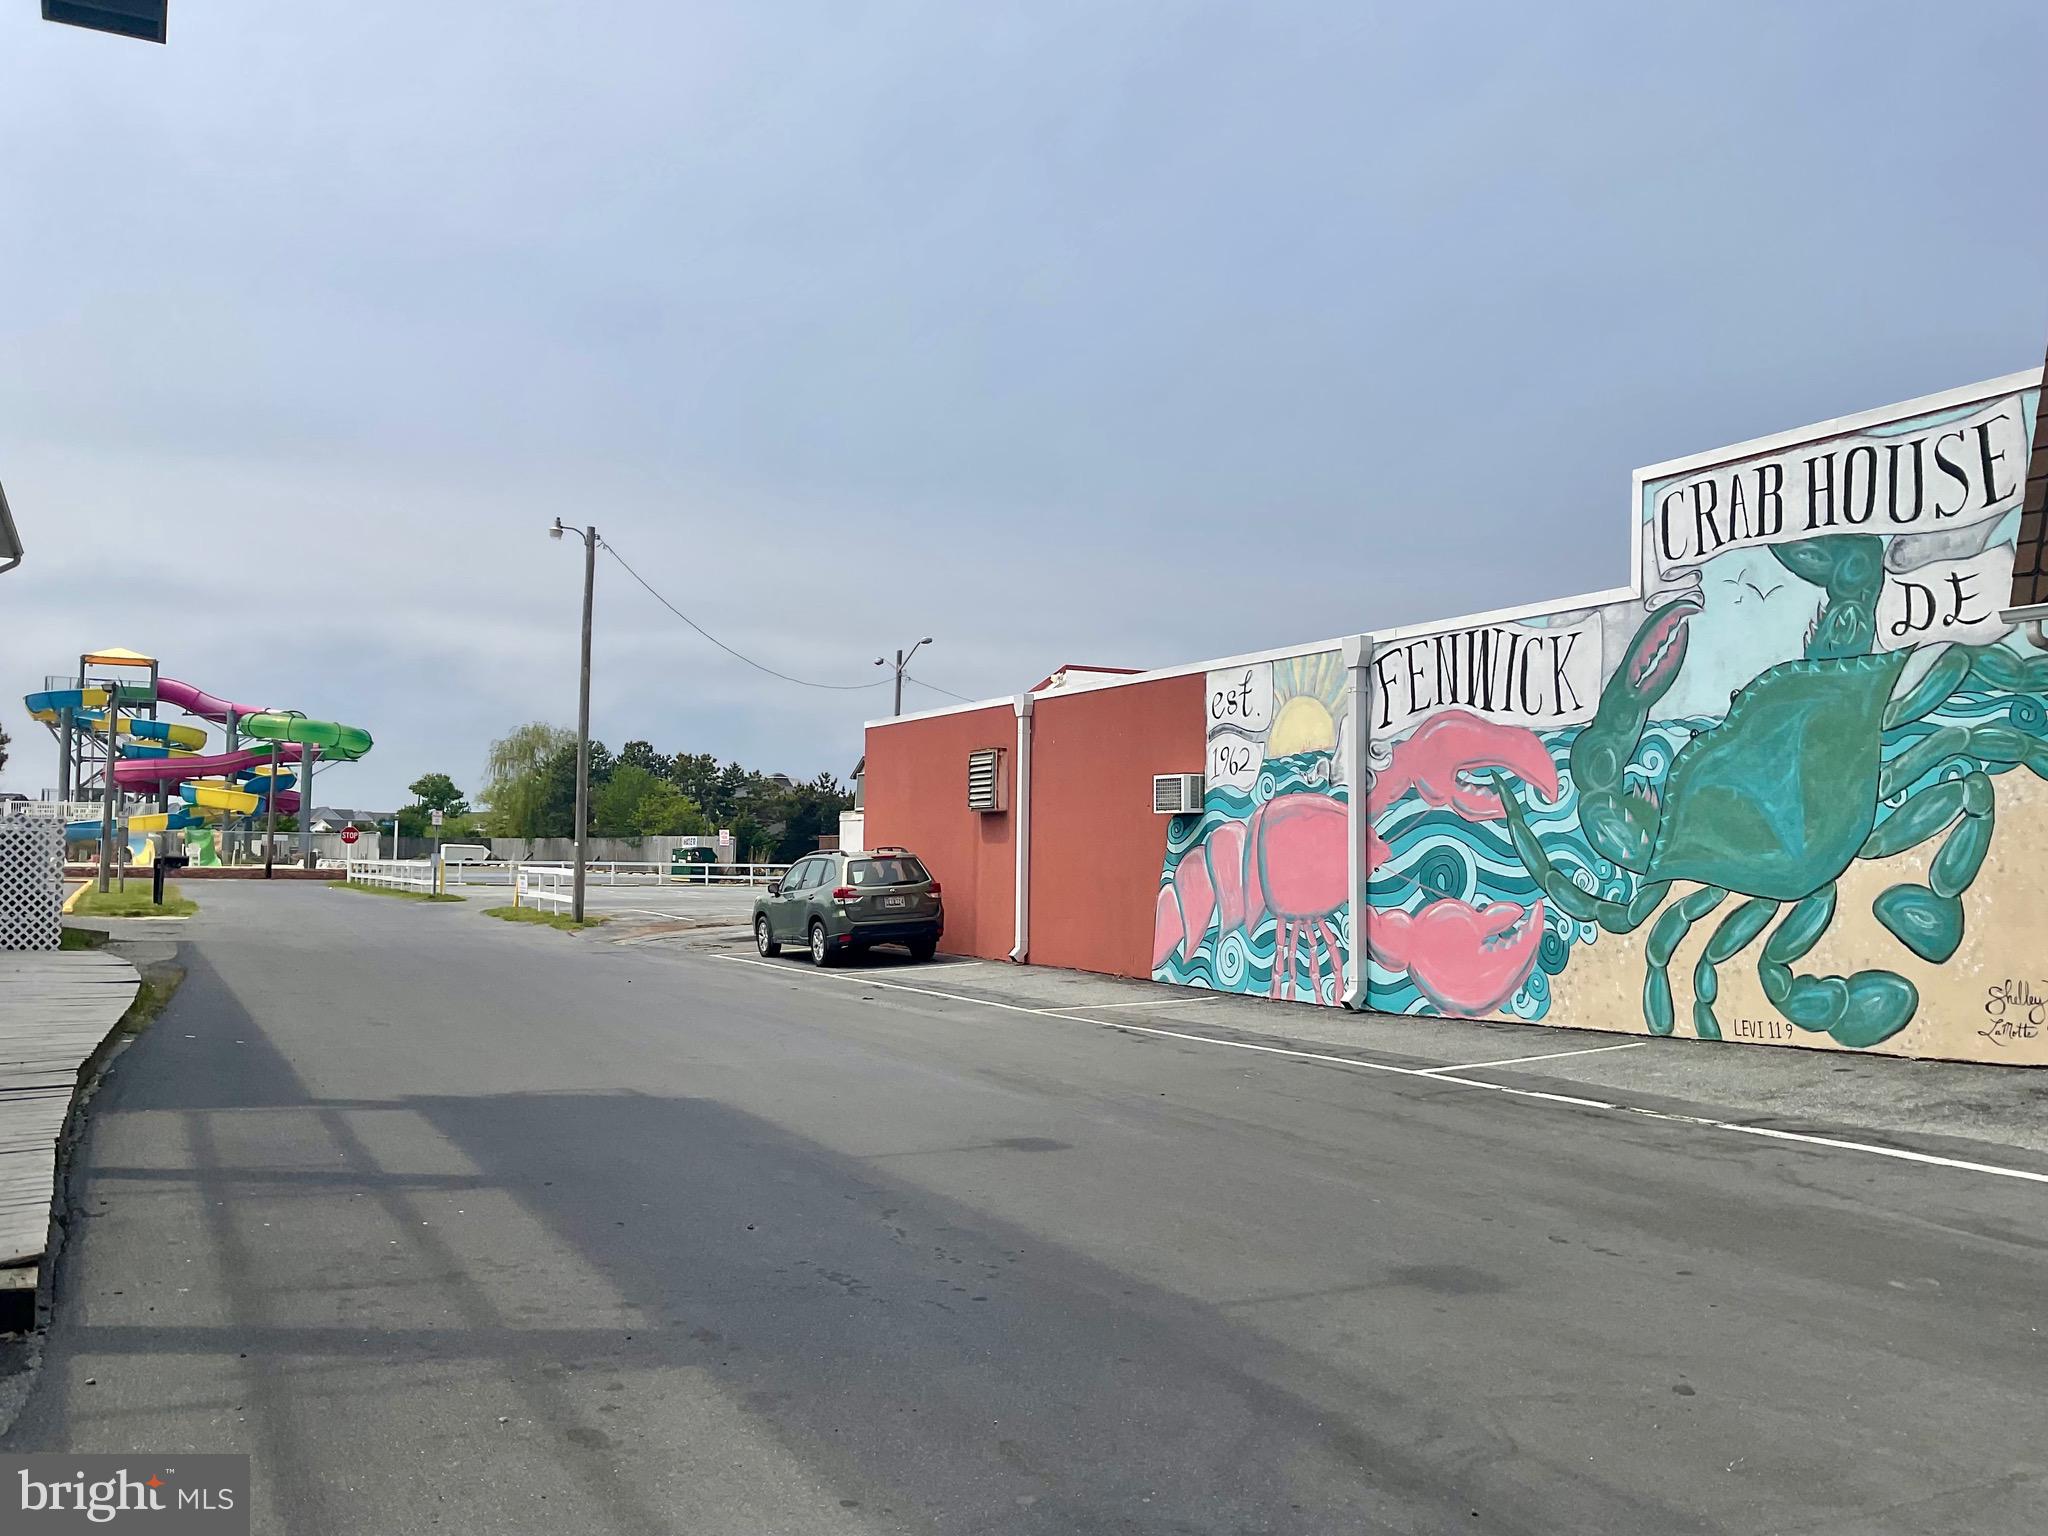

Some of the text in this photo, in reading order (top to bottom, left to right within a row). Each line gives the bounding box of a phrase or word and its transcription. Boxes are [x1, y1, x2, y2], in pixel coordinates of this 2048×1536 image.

[1660, 414, 2017, 561] CRAB HOUSE
[1891, 572, 1992, 636] DE
[1211, 669, 1261, 719] est.
[1373, 628, 1583, 729] FENWICK
[1211, 746, 1255, 779] 1962
[342, 831, 358, 839] STOP
[1734, 1019, 1764, 1038] LEVI
